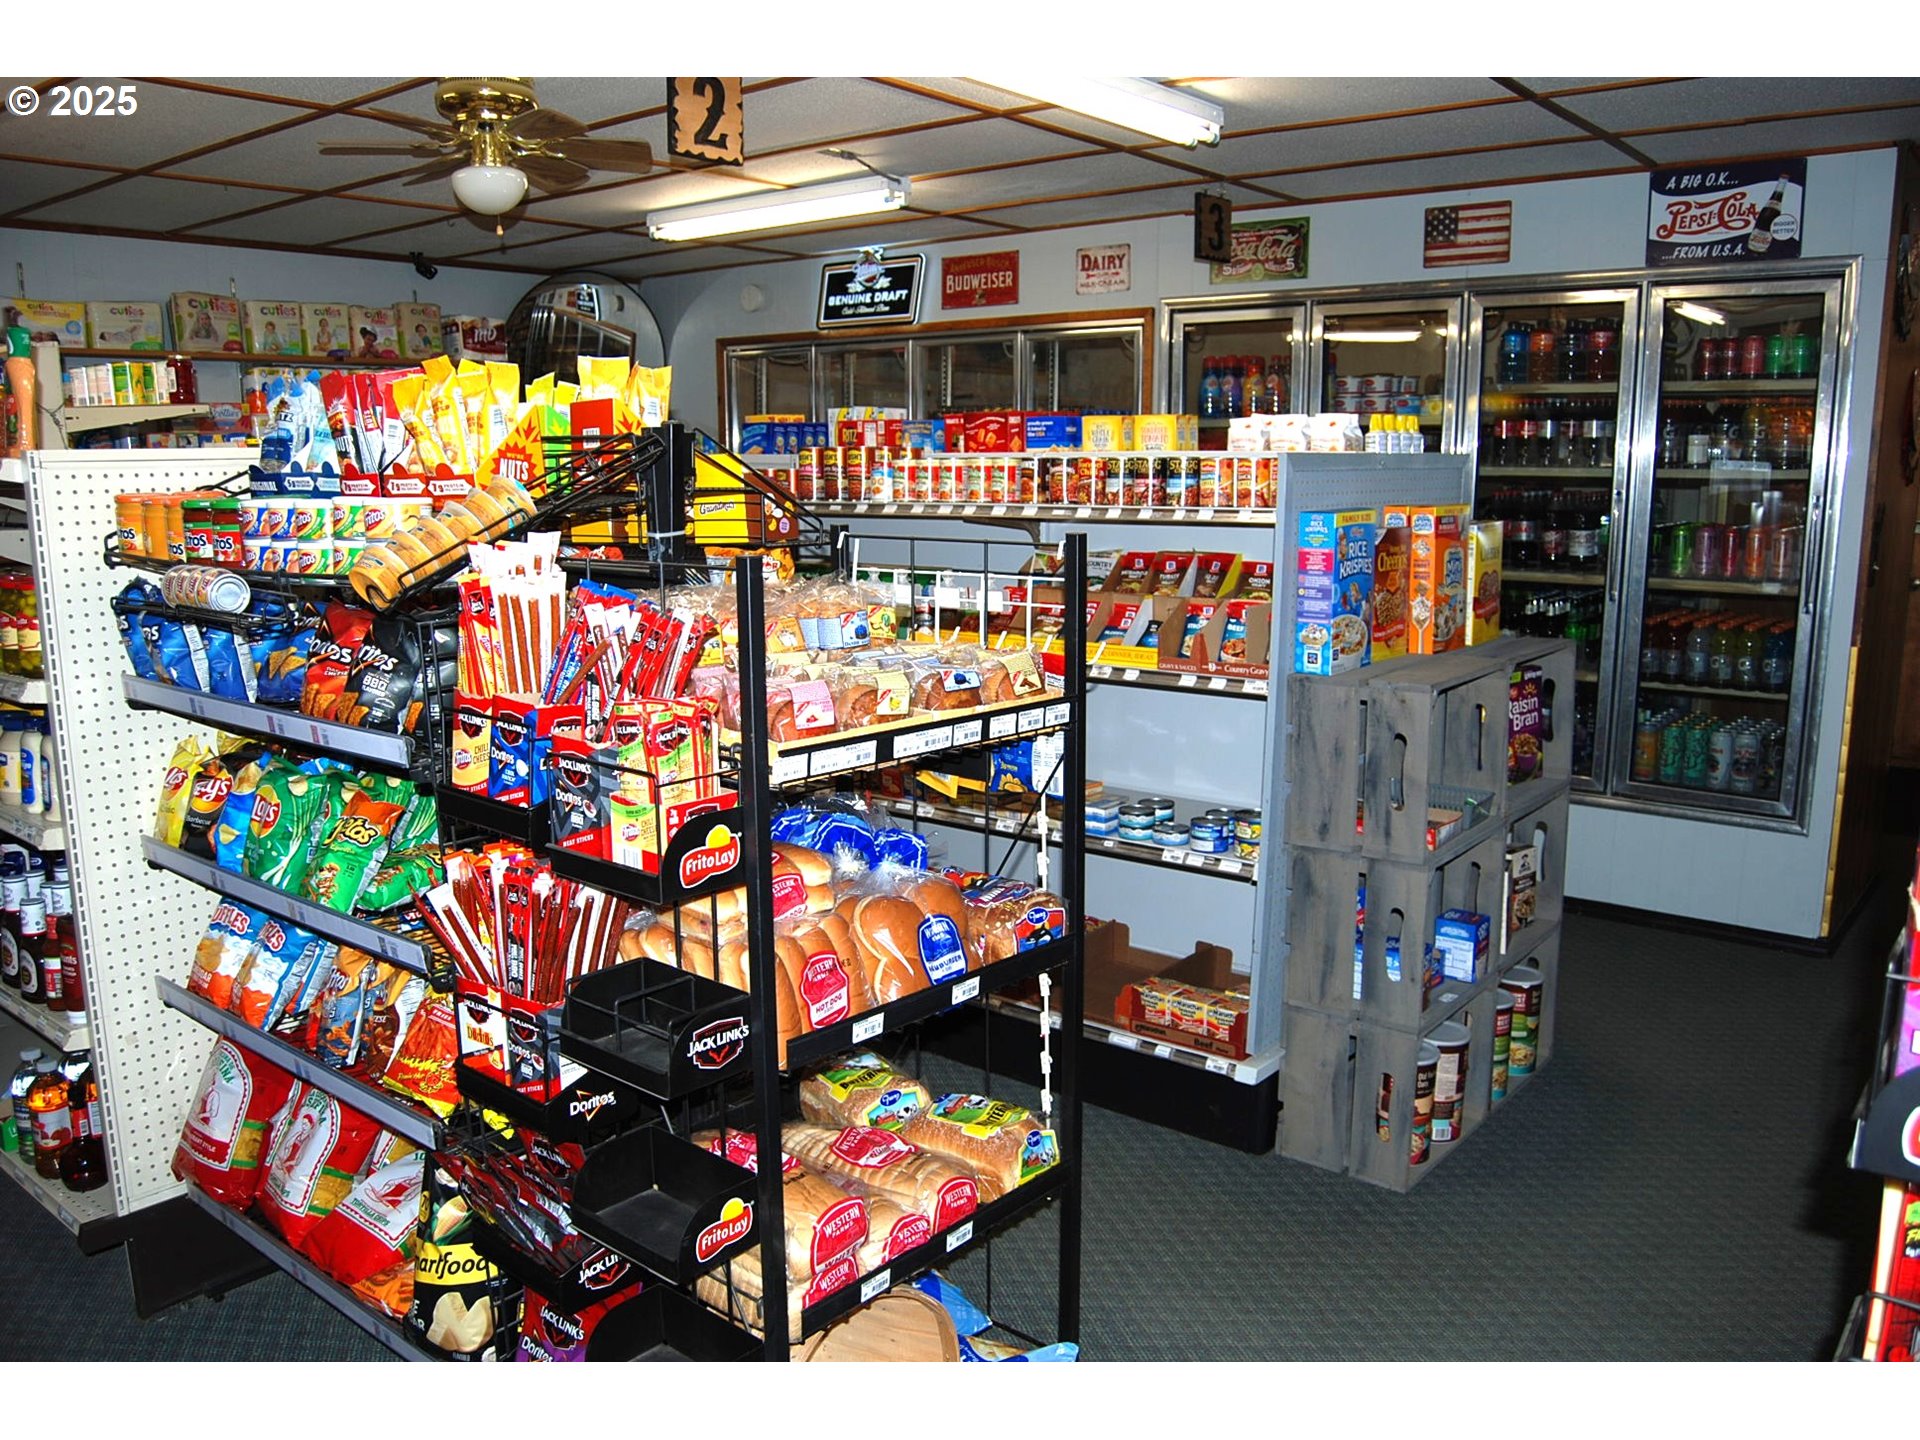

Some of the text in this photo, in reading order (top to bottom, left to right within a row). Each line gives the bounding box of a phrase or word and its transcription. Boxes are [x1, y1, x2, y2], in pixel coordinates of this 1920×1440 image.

[693, 77, 728, 150] 2
[1665, 175, 1676, 191] A
[1680, 173, 1703, 189] BIG
[1208, 202, 1225, 251] 3
[1712, 243, 1746, 257] U.S.A.
[1080, 252, 1128, 272] DAIRY
[946, 271, 1013, 294] BUDWEISER
[188, 298, 237, 313] cuties
[828, 289, 908, 307] GENUINE DRAFT
[110, 306, 145, 317] cuties
[260, 304, 298, 317] cuties
[314, 307, 341, 317] cuties
[842, 428, 858, 440] RITZ
[499, 458, 529, 482] NUTS
[1349, 540, 1367, 559] RICE
[1339, 558, 1372, 580] KRISPIES
[358, 643, 399, 671] ritos
[1513, 711, 1539, 731] Bran
[474, 743, 489, 755] CHILI
[491, 746, 515, 765] Doritos
[555, 788, 582, 807] Doritos
[815, 993, 843, 1014] HOT DOG
[687, 1026, 749, 1057] JACK LINK'S
[1194, 1037, 1213, 1049] Beef
[570, 1091, 616, 1116] Doritos
[944, 1184, 972, 1206] WESTERN
[950, 1198, 968, 1209] FARMS
[822, 1204, 861, 1238] WESTERN
[831, 1221, 854, 1239] FARMS
[578, 1260, 605, 1284] JACK
[818, 1261, 850, 1291] WESTERN
[540, 1305, 559, 1329] JACK
